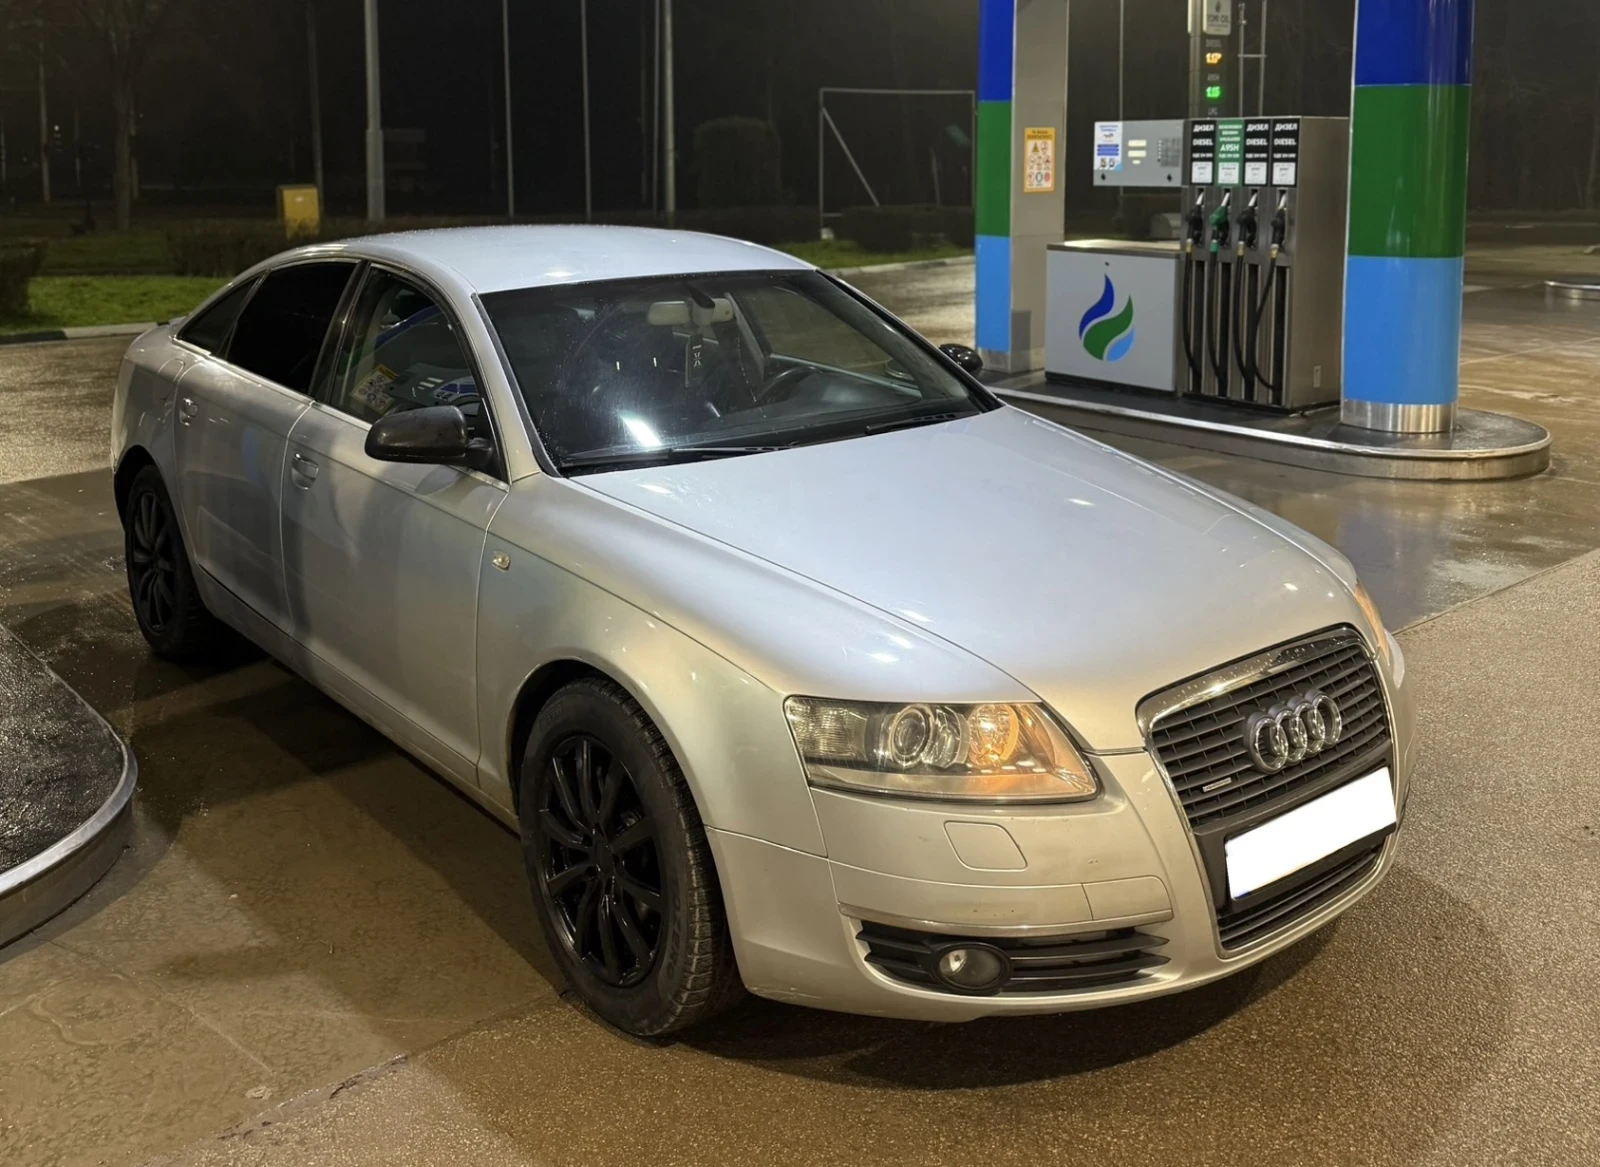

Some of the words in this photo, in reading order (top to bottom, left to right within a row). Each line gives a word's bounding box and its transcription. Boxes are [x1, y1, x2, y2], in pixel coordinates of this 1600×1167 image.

[1193, 124, 1214, 132] ДИЗЕЛ
[1246, 124, 1269, 132] ДИЗЕЛ
[1275, 123, 1298, 132] ДИЗЕЛ
[1246, 138, 1268, 146] DIESEL
[1274, 138, 1296, 146] DIESEL
